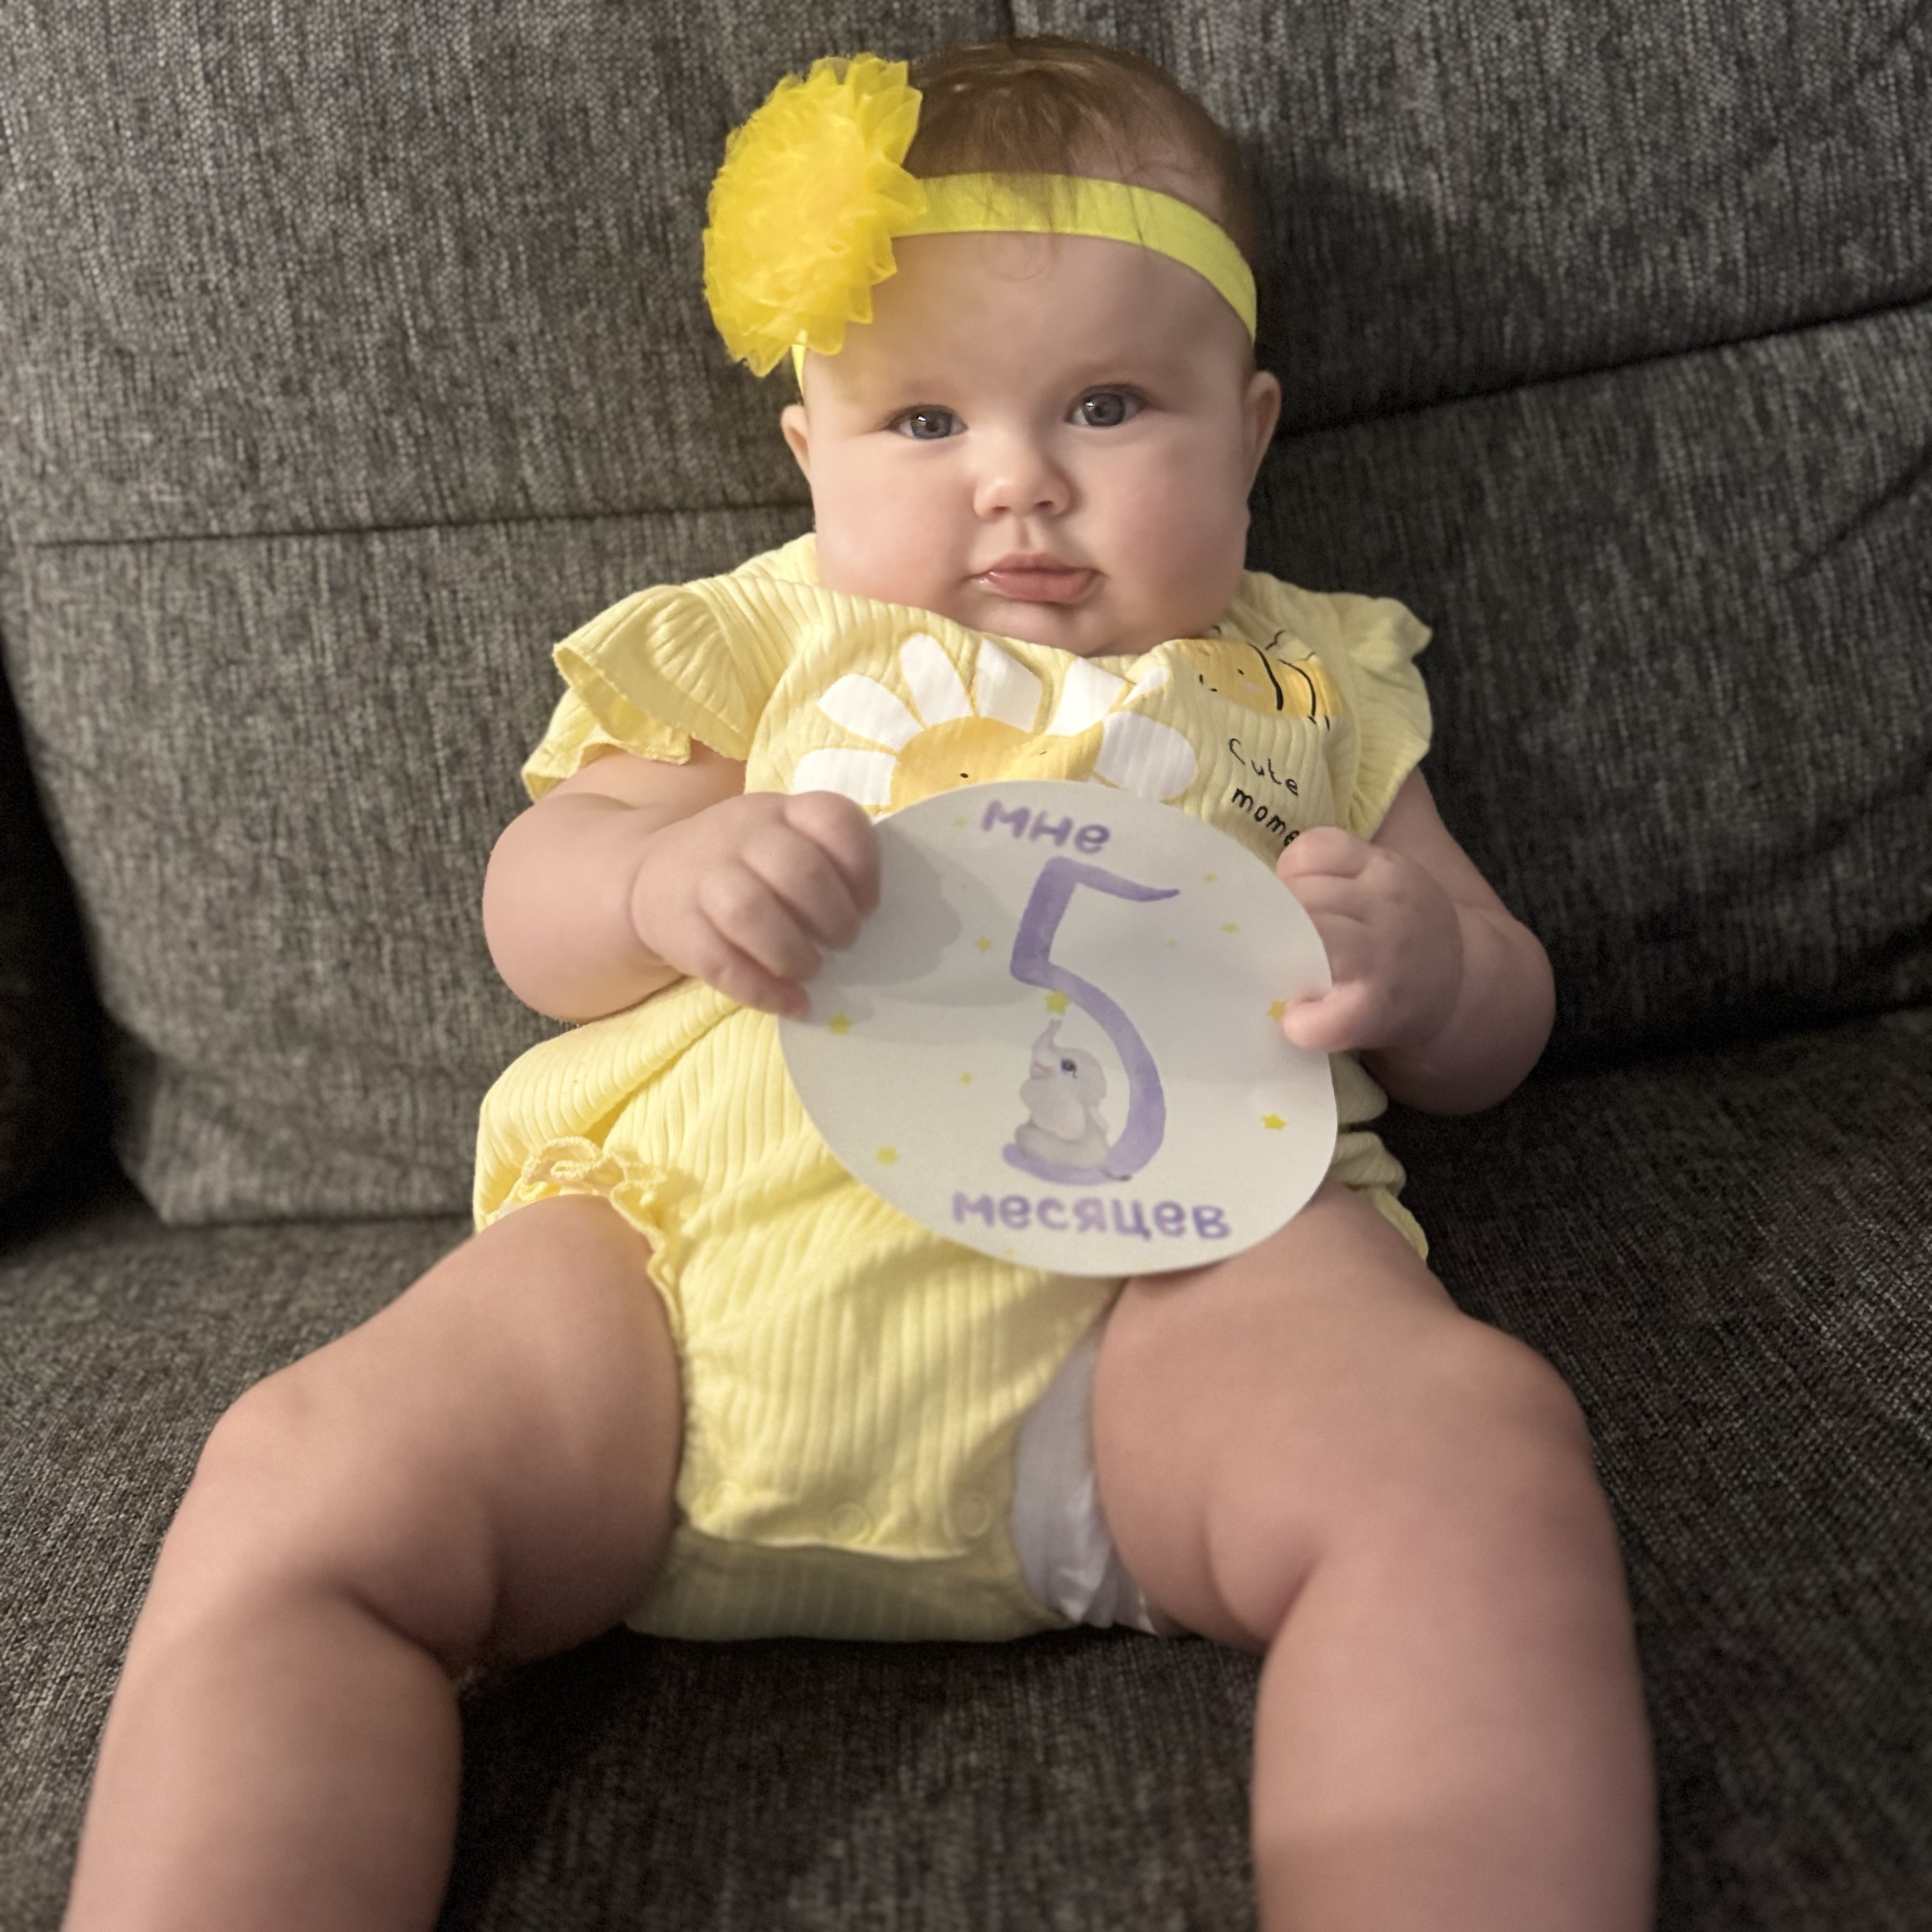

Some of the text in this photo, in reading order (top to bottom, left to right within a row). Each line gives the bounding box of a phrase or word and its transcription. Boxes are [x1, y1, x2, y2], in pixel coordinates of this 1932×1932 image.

[1229, 738, 1299, 797] Cute
[981, 799, 1111, 855] мне
[1001, 855, 1181, 1187] 5
[952, 1191, 1232, 1241] месяцев
